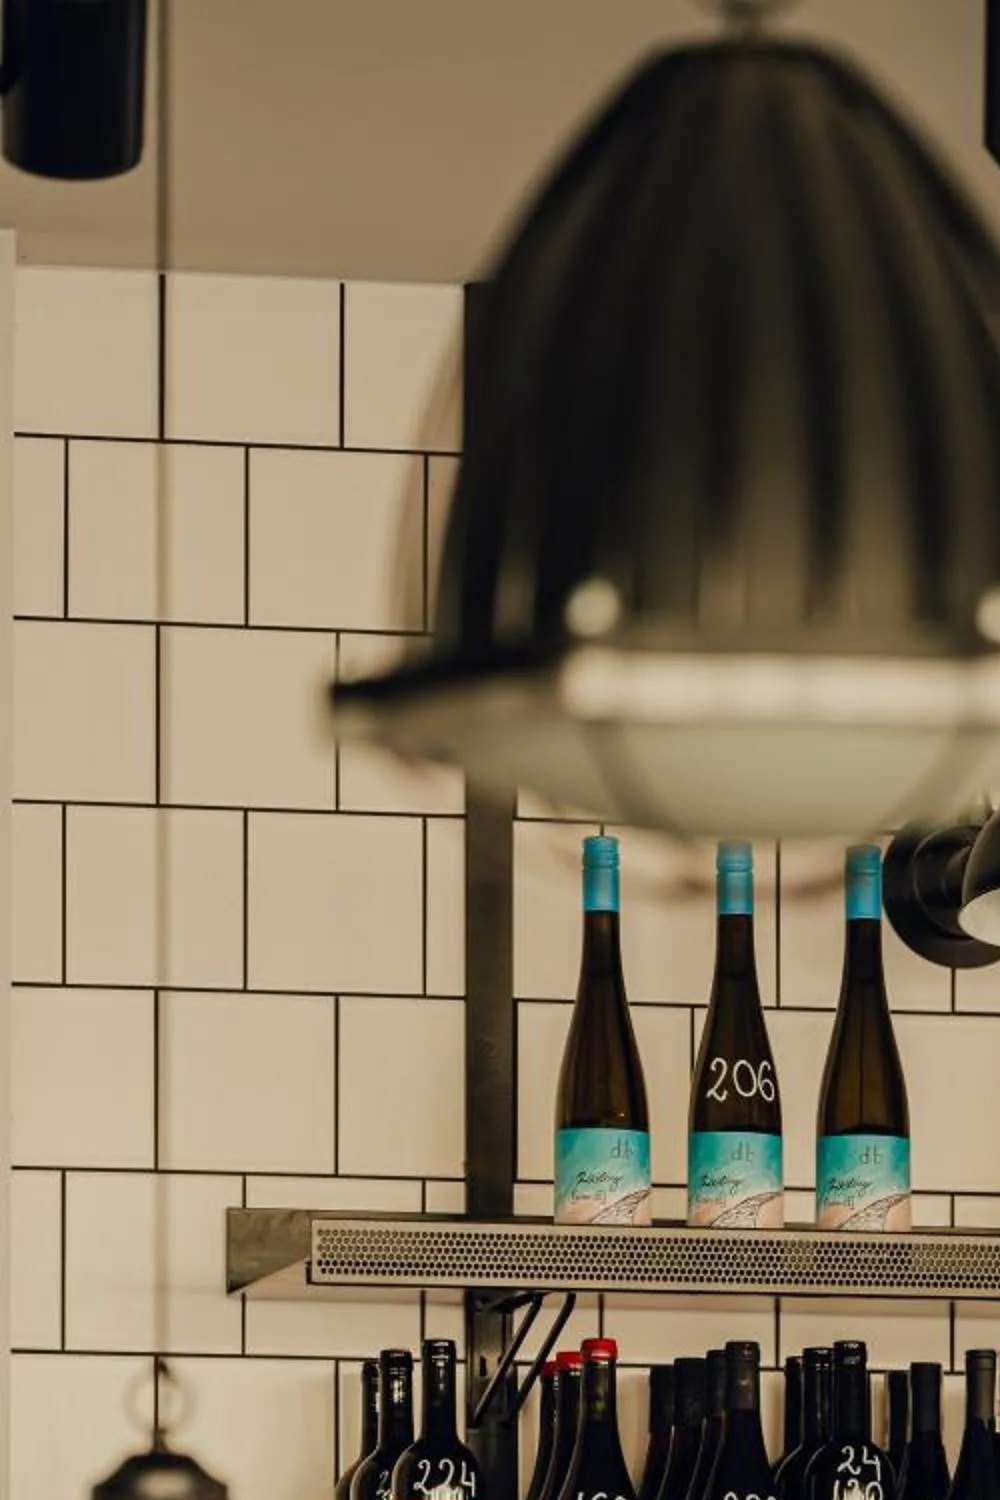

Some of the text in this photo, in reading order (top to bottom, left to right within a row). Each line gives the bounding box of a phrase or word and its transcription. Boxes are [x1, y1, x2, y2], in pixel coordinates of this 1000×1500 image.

[705, 1057, 776, 1102] 206
[413, 1458, 476, 1498] 224
[837, 1445, 881, 1482] 24
